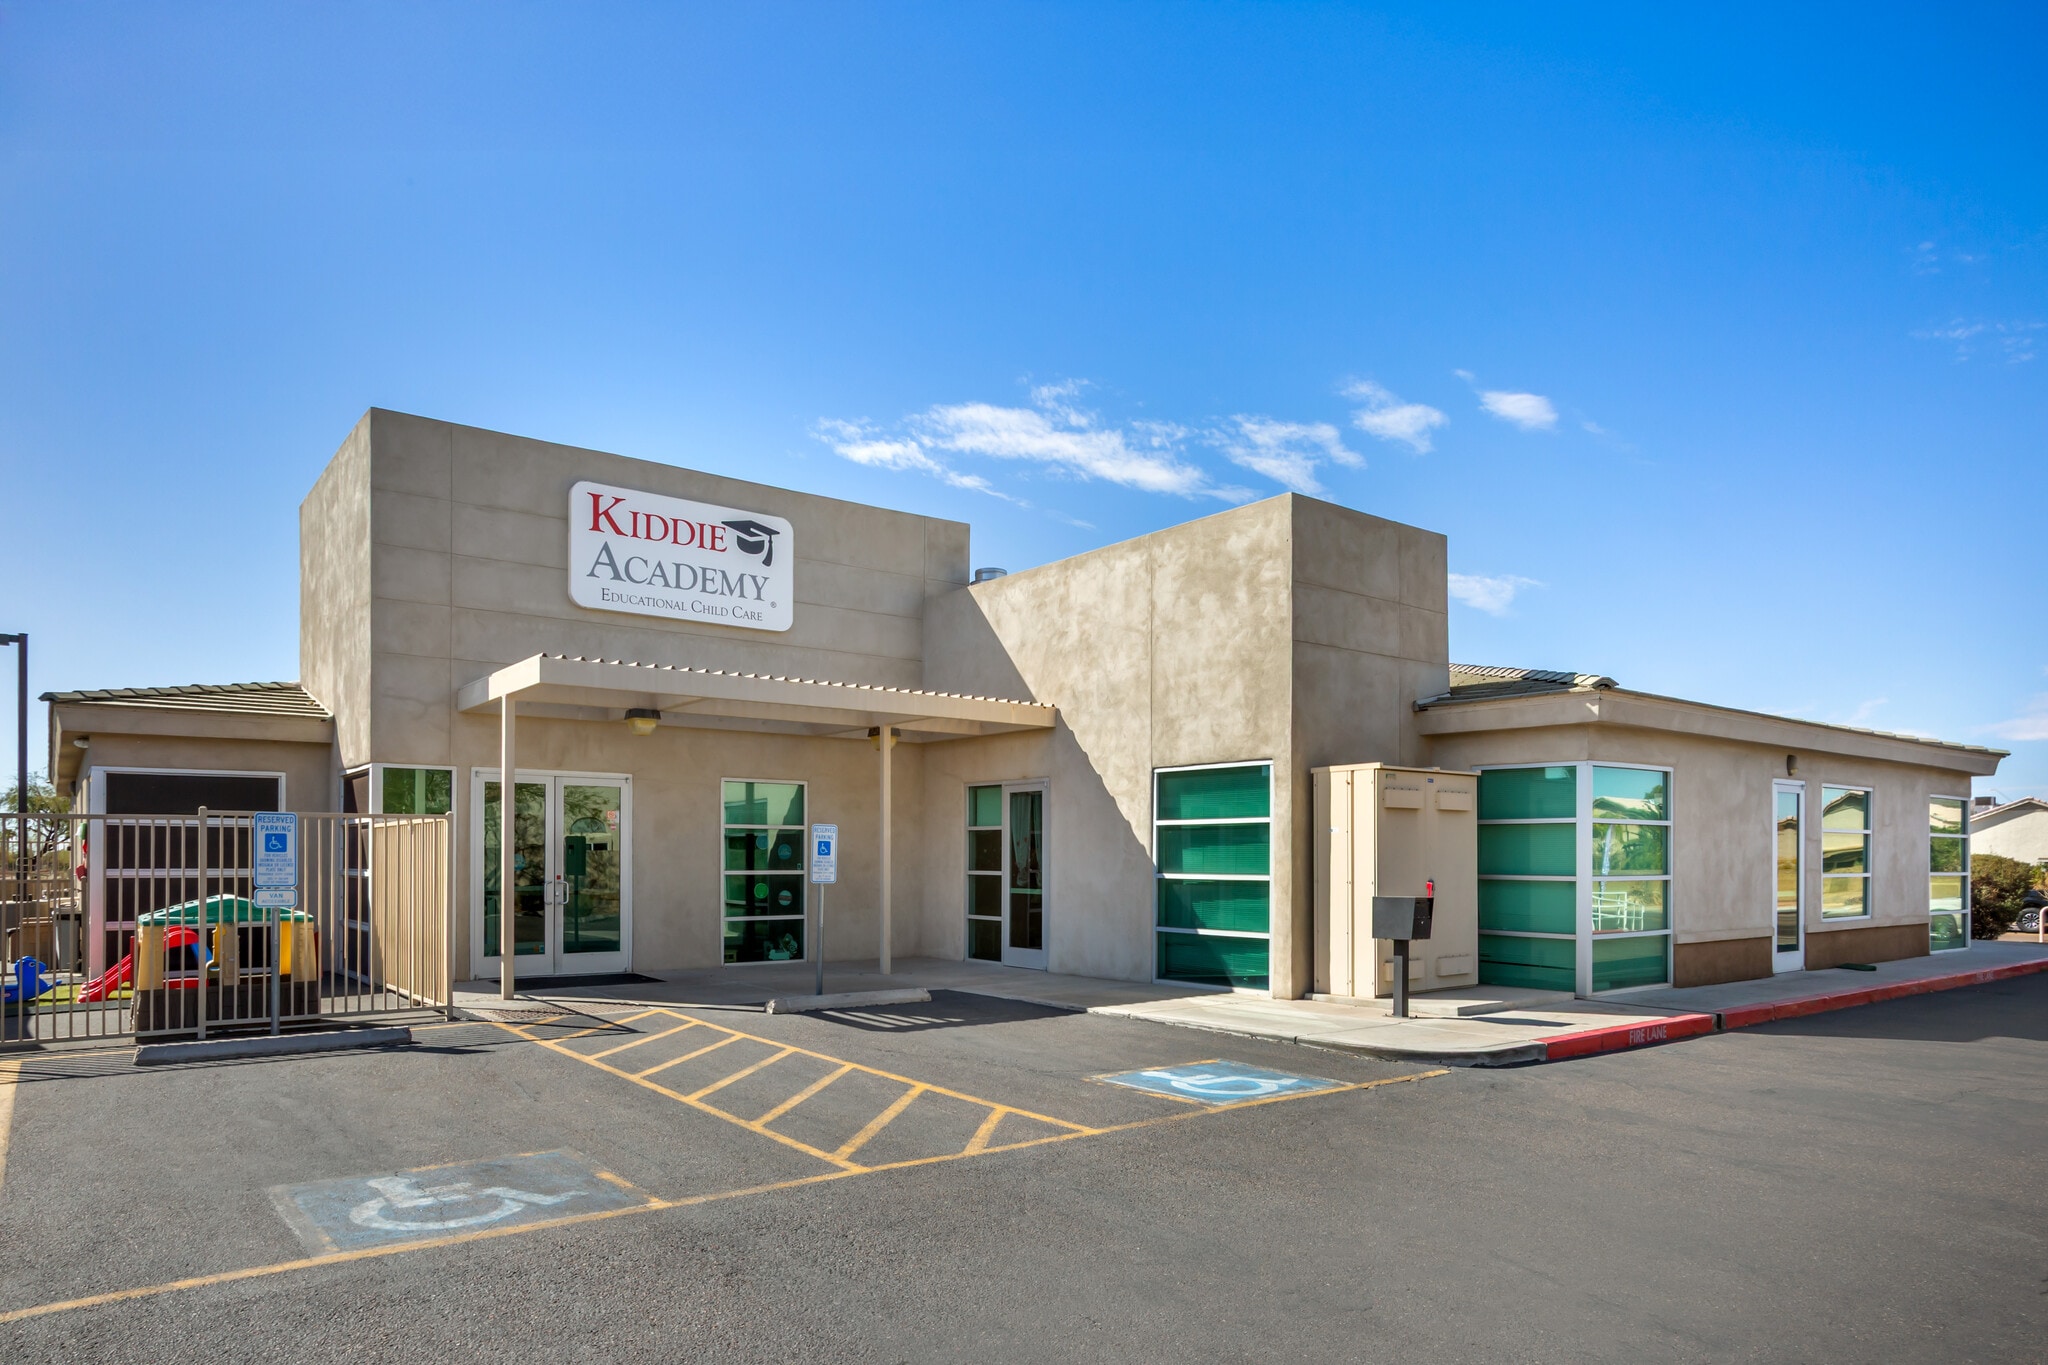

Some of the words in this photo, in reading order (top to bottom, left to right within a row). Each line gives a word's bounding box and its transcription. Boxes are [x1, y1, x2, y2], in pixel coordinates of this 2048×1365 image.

[587, 491, 728, 553] KIDDIE
[586, 541, 771, 602] ACADEMY
[601, 588, 688, 612] EDUCATIONAL
[691, 601, 729, 617] CHILD
[732, 606, 763, 621] CARE
[258, 815, 294, 824] RESERVED
[260, 824, 292, 833] PARKING
[1629, 1028, 1645, 1044] FIRE
[1647, 1025, 1667, 1041] LANE
